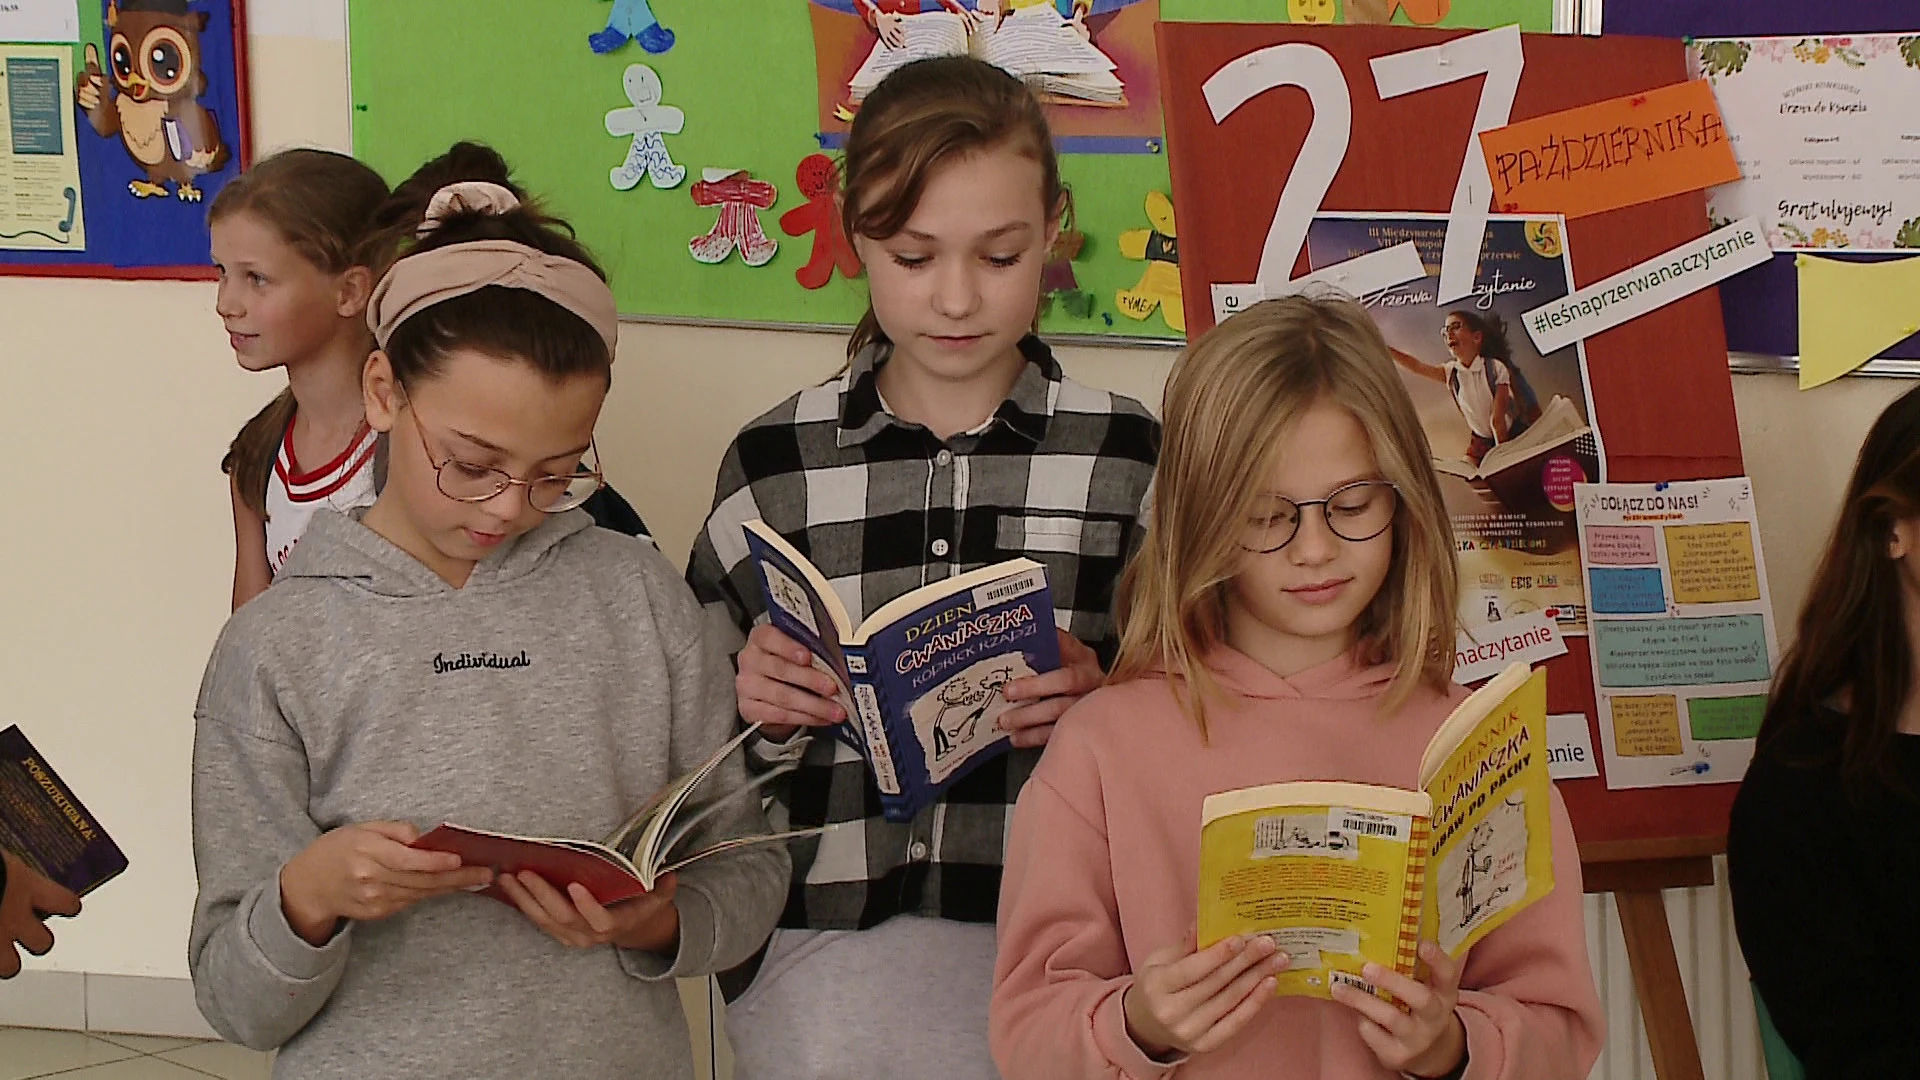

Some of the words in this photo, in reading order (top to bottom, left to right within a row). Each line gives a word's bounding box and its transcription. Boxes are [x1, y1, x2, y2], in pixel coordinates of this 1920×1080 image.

[1202, 24, 1525, 308] 27
[1778, 200, 1892, 226] Gratulujemy!
[1473, 268, 1536, 309] zytanie
[1534, 229, 1756, 334] #leśnaprzerwanaczytanie
[1222, 295, 1239, 314] ie
[1601, 497, 1645, 514] DOŁĄCZ
[1648, 498, 1665, 510] DO
[1667, 496, 1699, 510] NAS!
[895, 604, 1034, 675] CWANIACZKA
[905, 602, 973, 643] DZIEN
[433, 650, 531, 673] Individual
[1456, 625, 1552, 667] naczytanie
[1442, 707, 1519, 793] DZIENNIK
[1547, 743, 1585, 764] anie
[1431, 725, 1530, 831] CWANIACZKA
[1431, 812, 1465, 857] UBAW
[1468, 794, 1487, 816] PO
[1490, 752, 1532, 796] PACHY
